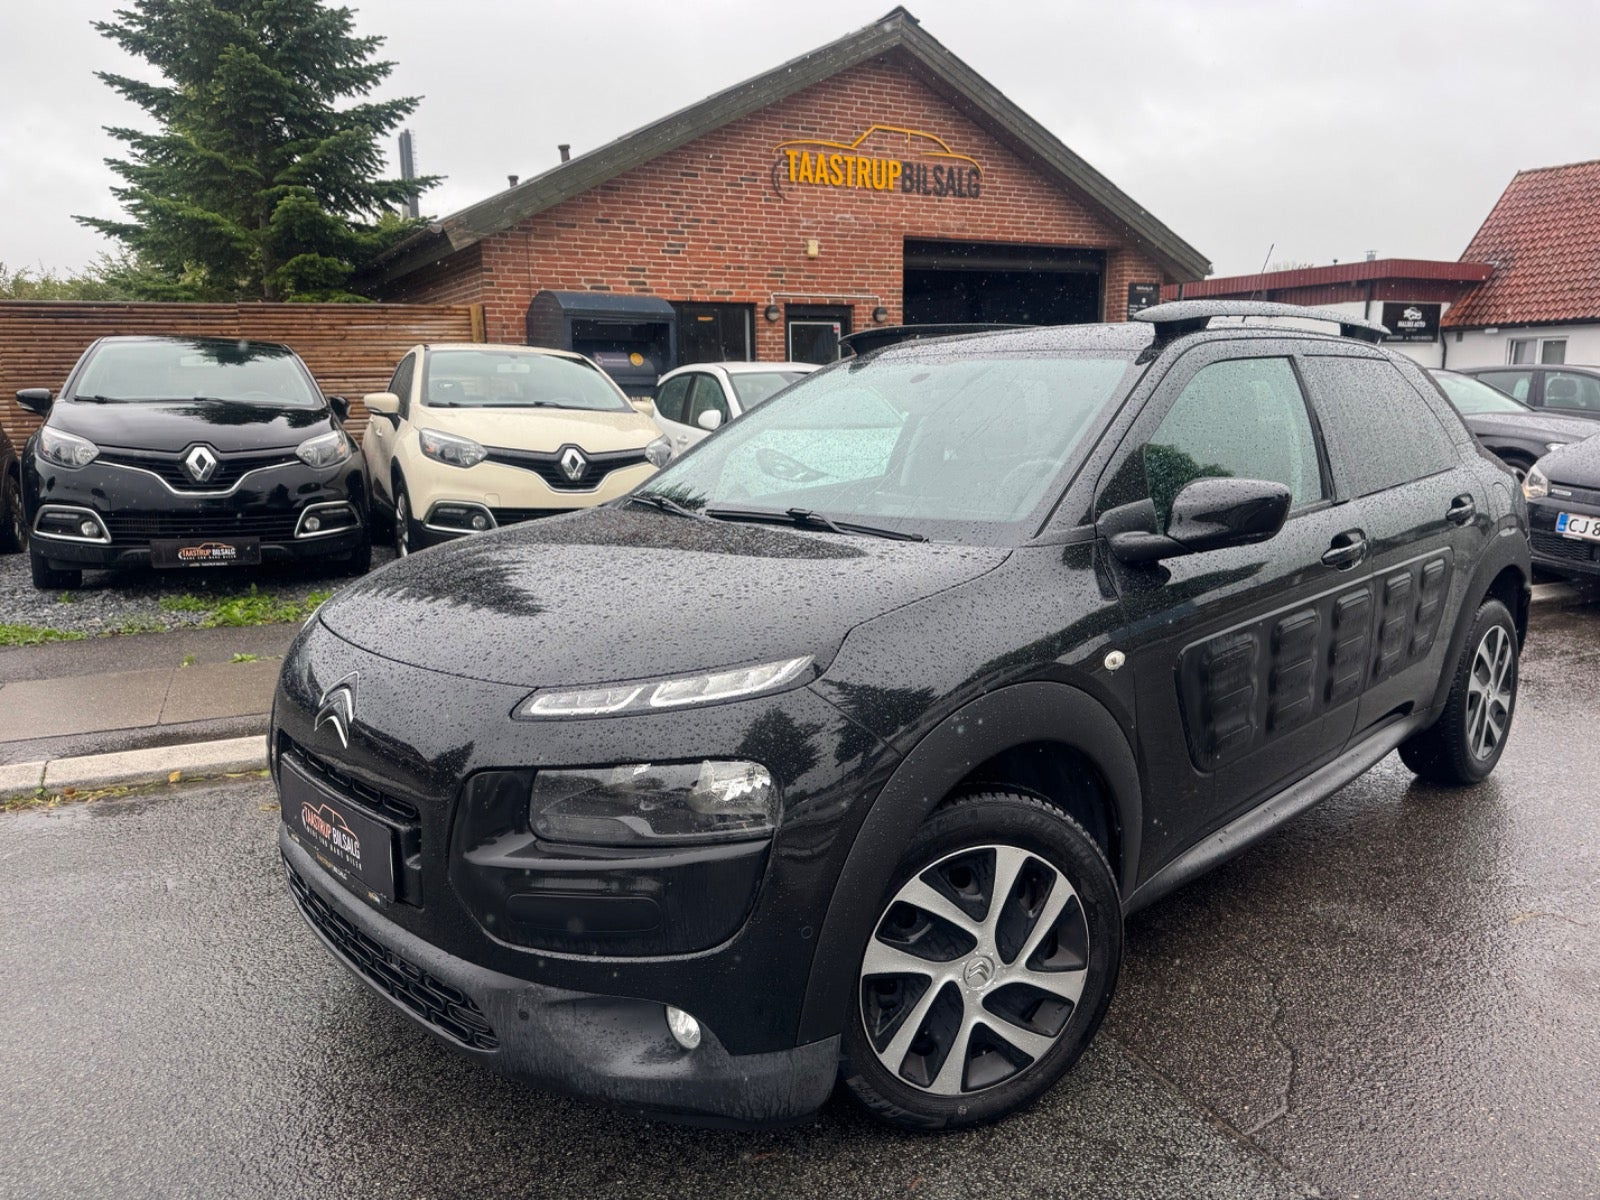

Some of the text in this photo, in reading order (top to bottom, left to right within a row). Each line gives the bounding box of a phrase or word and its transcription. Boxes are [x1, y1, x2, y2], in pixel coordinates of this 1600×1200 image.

[1569, 518, 1589, 533] CJ
[304, 806, 331, 840] TAASTRUP
[333, 828, 360, 859] BILSALG
